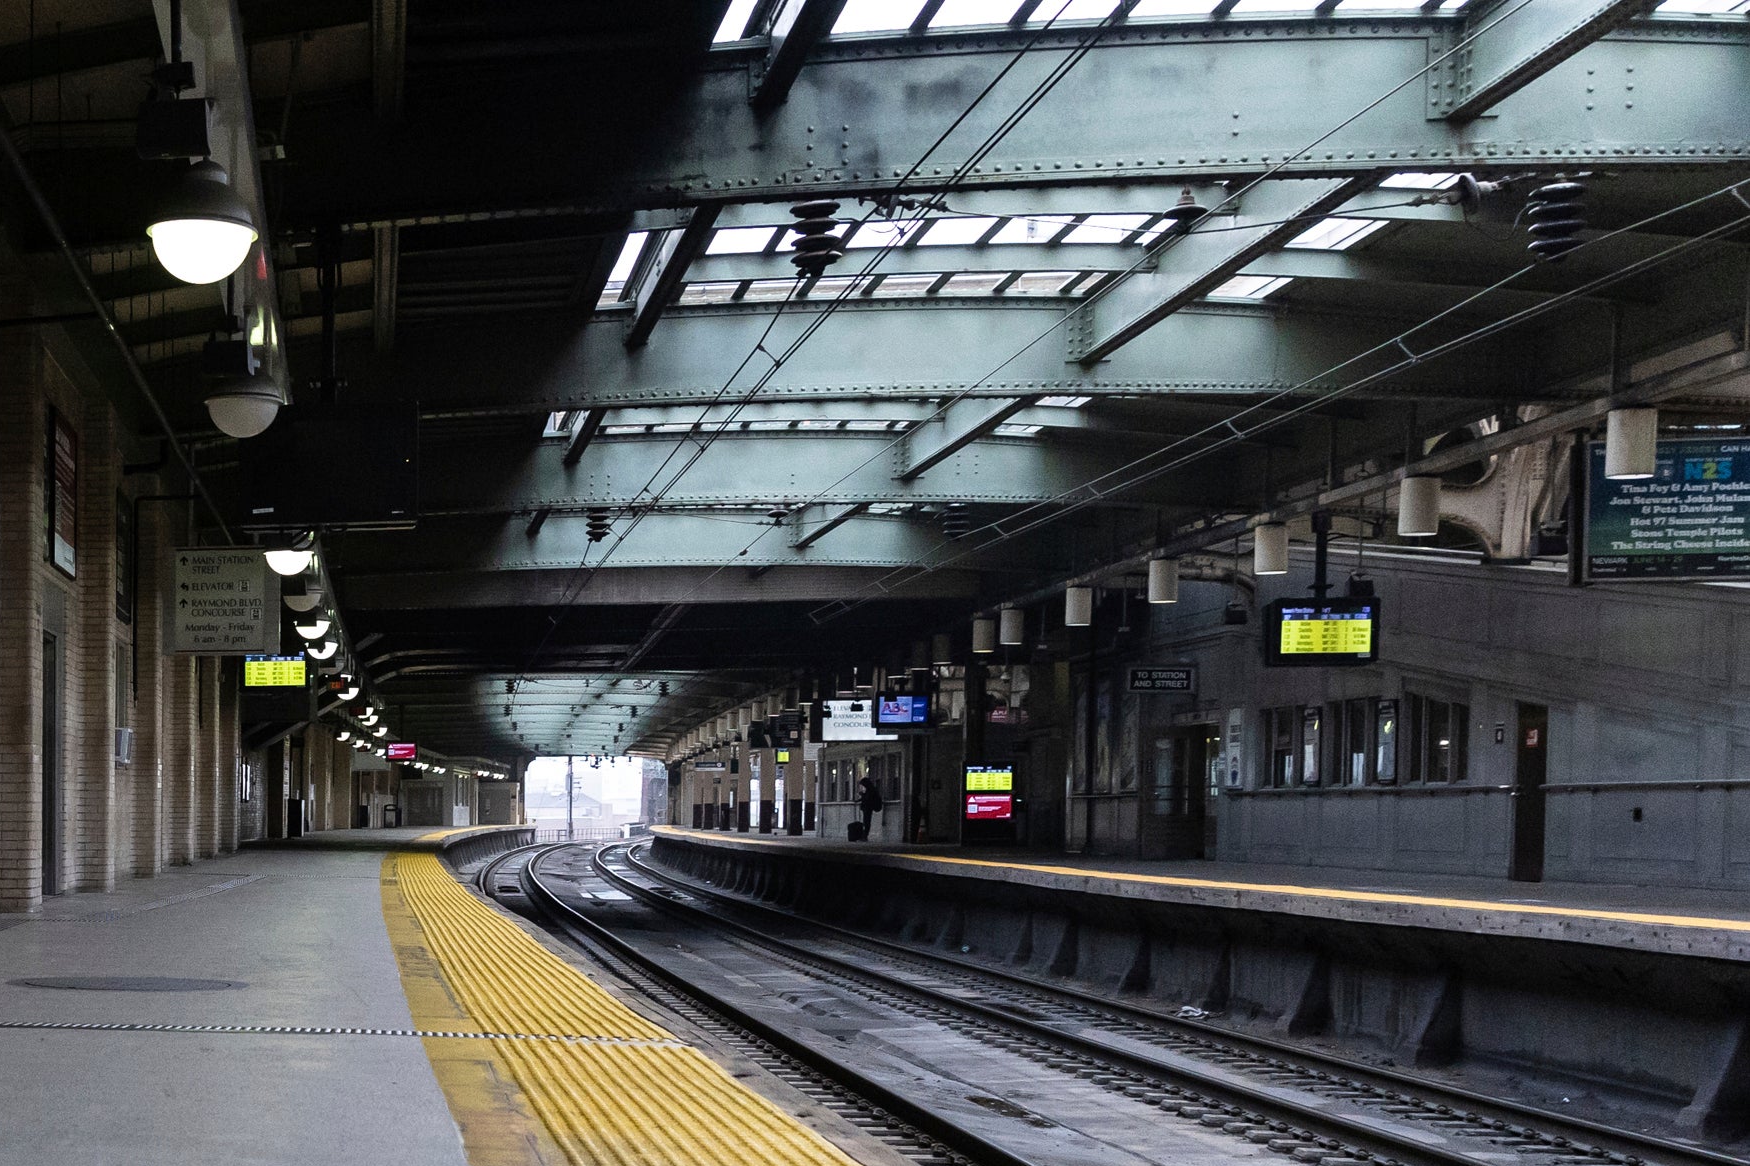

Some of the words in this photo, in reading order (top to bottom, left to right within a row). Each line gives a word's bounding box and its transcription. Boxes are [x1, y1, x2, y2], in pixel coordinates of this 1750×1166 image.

[1683, 461, 1733, 480] N2S
[1620, 485, 1648, 494] Tina
[1649, 484, 1669, 494] Fey
[1670, 484, 1681, 492] &
[1682, 483, 1710, 493] Amy
[1711, 481, 1750, 491] Poehle
[1610, 497, 1631, 505] Jon
[1632, 496, 1683, 505] Stewart,
[1684, 495, 1713, 503] John
[1715, 494, 1750, 502] Mulan
[1641, 505, 1651, 514] &
[1653, 505, 1678, 514] Pete
[1679, 504, 1734, 513] Davidson
[1630, 518, 1651, 526] Hot
[1653, 517, 1668, 526] 97
[1668, 516, 1718, 525] Summer
[1719, 515, 1745, 524] Jam
[1630, 529, 1664, 538] Stone
[1666, 528, 1709, 538] Temple
[1710, 527, 1744, 536] Pilots
[1611, 541, 1634, 550] The
[1634, 540, 1671, 550] String
[1673, 540, 1713, 548] Cheese
[1714, 538, 1750, 548] Incide
[192, 556, 215, 564] MAIN
[218, 555, 253, 564] STATION
[192, 565, 220, 575] STREET
[191, 582, 234, 591] ELEVATOR
[191, 598, 237, 607] RAYMOND
[191, 608, 246, 617] CONCOURSE
[185, 623, 220, 633] Monday
[228, 622, 255, 634] Friday
[194, 635, 200, 643] 6
[224, 635, 229, 643] 8
[232, 636, 246, 645] pm
[1136, 671, 1149, 679] TO
[1151, 671, 1187, 680] STATION
[1133, 680, 1152, 688] AND
[1154, 680, 1188, 688] STREET
[882, 702, 909, 714] ABC
